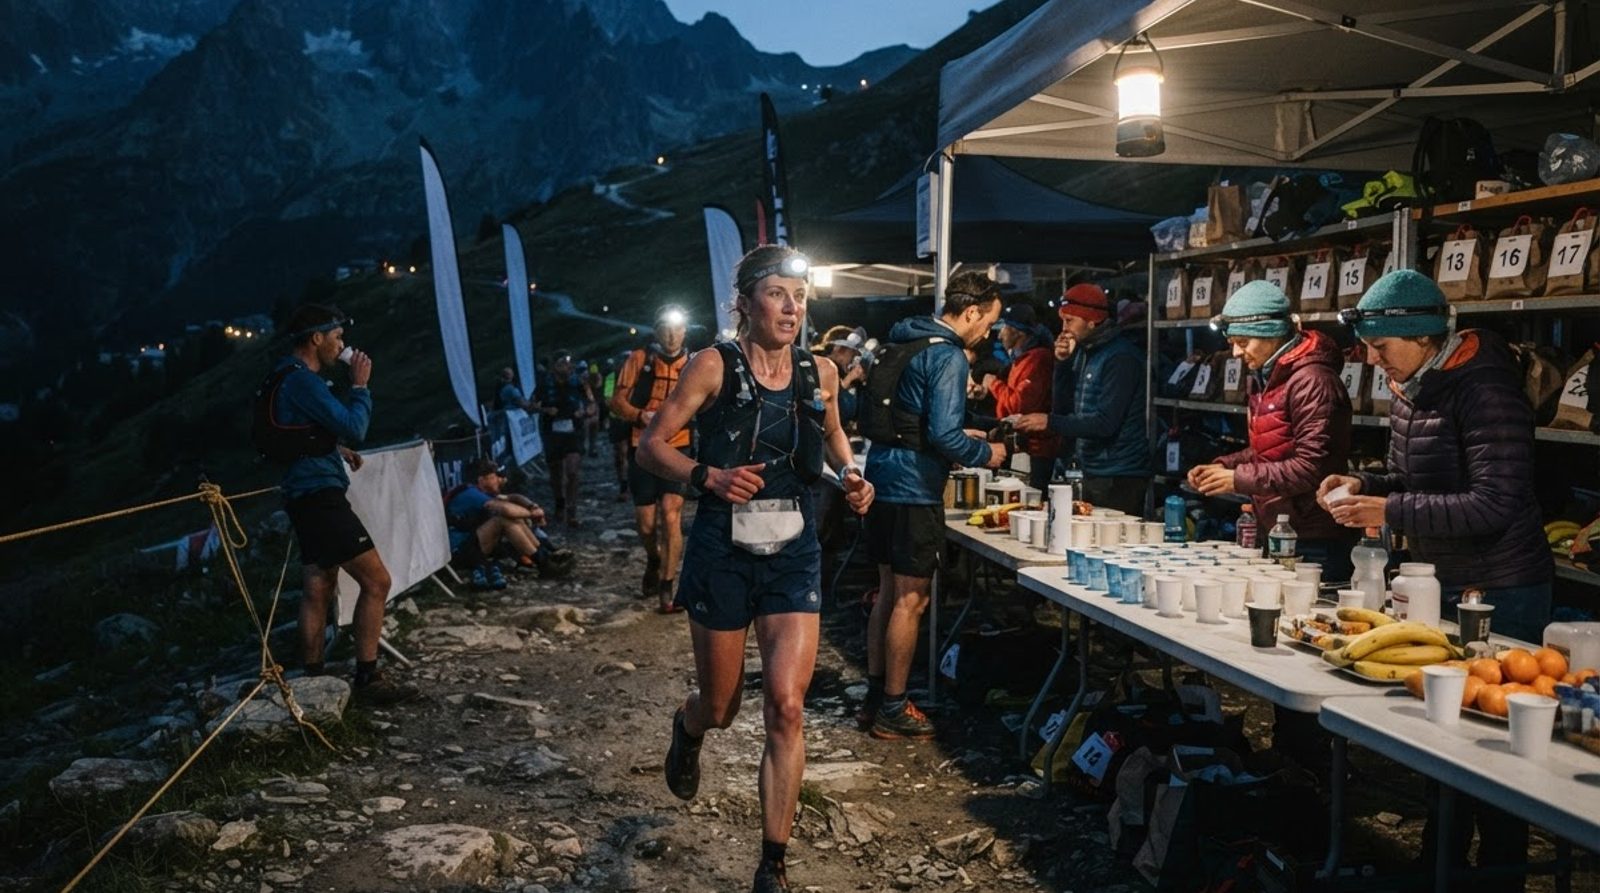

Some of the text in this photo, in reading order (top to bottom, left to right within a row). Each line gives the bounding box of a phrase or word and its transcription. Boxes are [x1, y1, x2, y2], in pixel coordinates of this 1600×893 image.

[1446, 253, 1464, 271] 13
[1500, 248, 1521, 268] 16
[1557, 245, 1581, 265] 17
[1308, 275, 1322, 290] 14
[1345, 269, 1359, 286] 15
